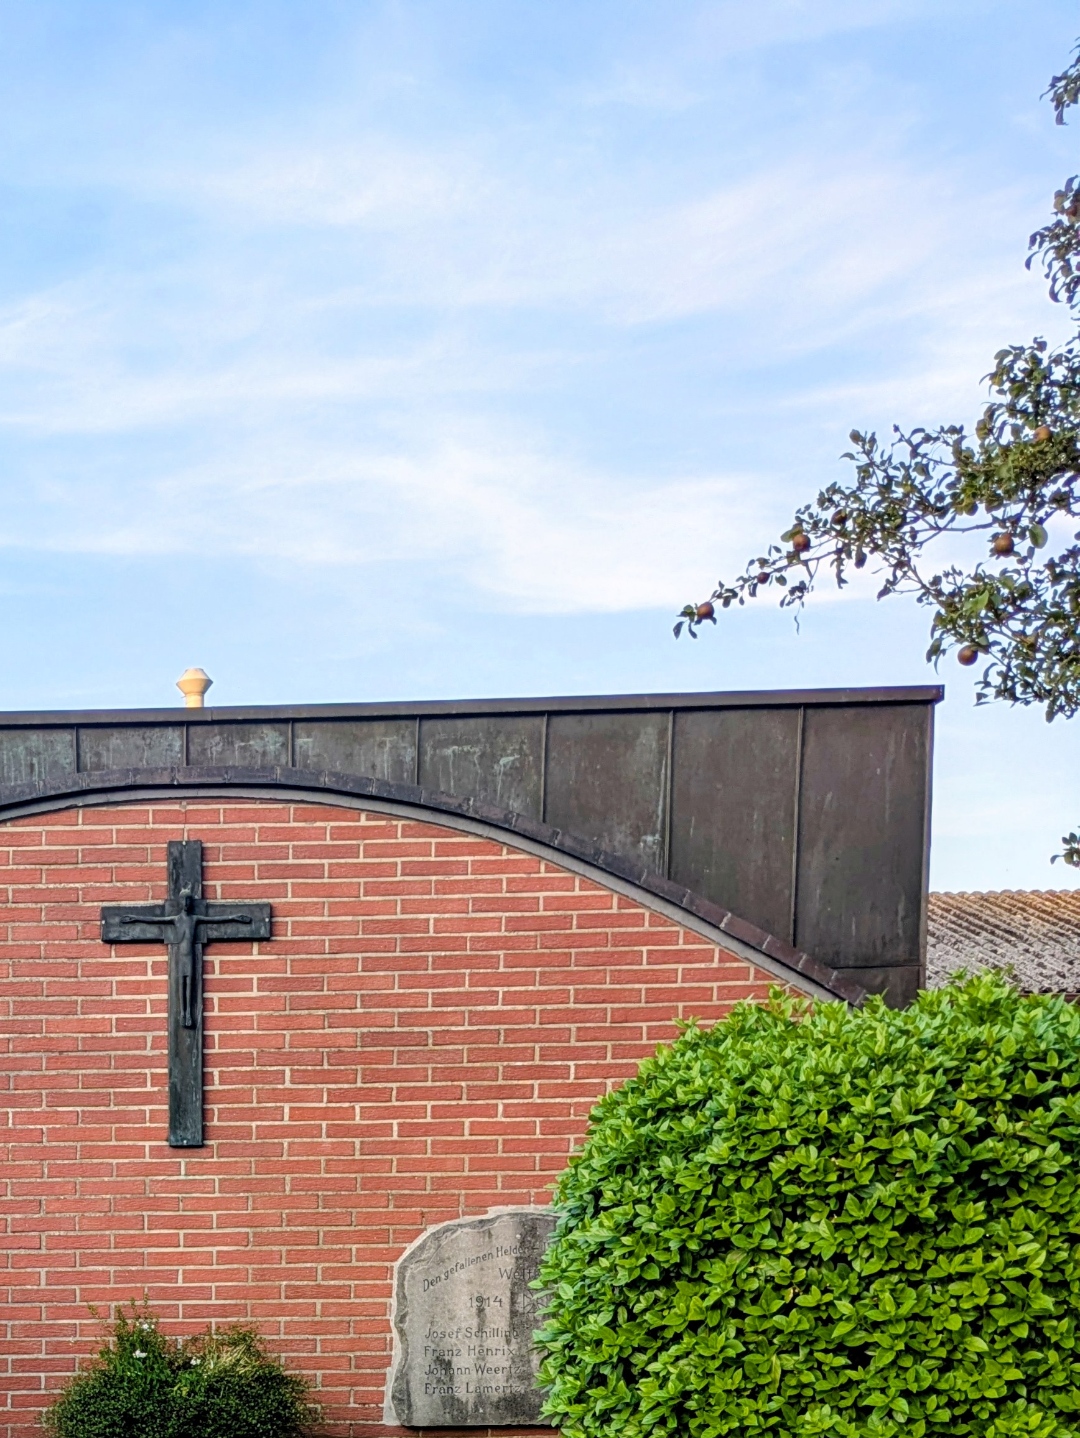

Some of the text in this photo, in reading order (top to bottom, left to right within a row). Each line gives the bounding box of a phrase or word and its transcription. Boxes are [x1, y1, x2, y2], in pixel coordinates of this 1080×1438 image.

[422, 1276, 441, 1293] Den
[443, 1251, 494, 1281] gefallenen
[469, 1295, 503, 1309] 1914
[424, 1327, 520, 1339] Josef Schilling
[424, 1345, 516, 1358] Franz Henrix
[424, 1363, 522, 1375] Johann Weertz
[424, 1382, 522, 1394] Franz Lamertz
